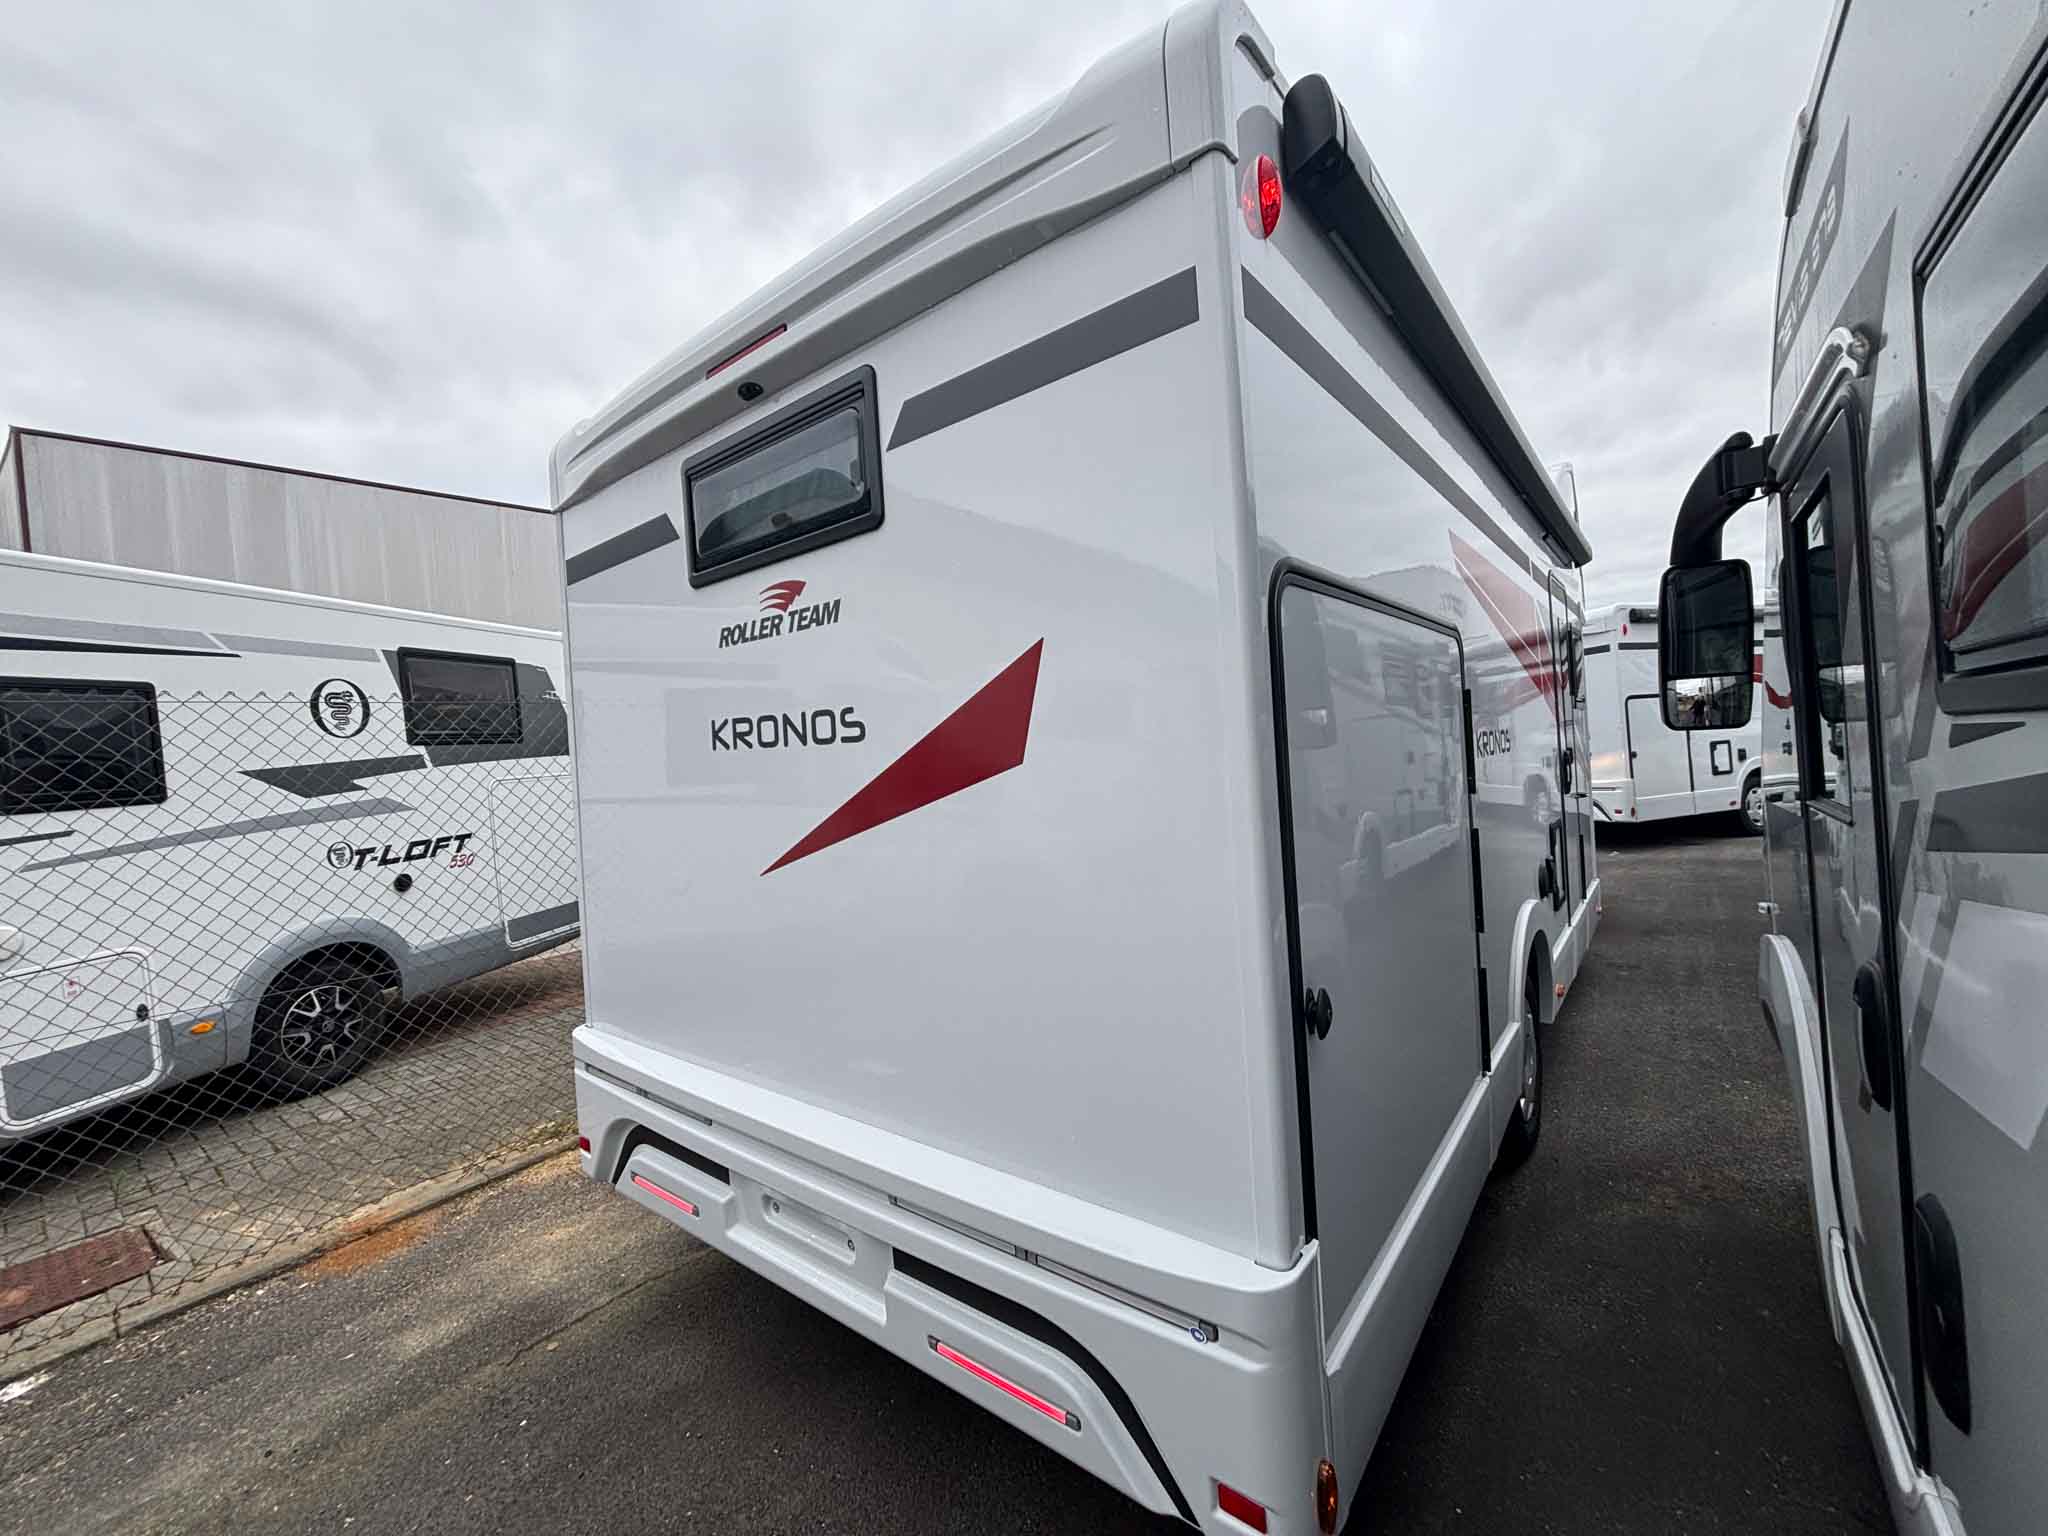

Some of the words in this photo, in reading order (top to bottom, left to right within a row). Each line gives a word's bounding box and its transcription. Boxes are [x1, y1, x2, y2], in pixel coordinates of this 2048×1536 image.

[719, 613, 784, 649] ROLLER
[788, 598, 841, 633] TEAM
[711, 706, 866, 751] KRONOS
[1476, 729, 1511, 759] KRONOS
[353, 832, 473, 871] T-LOFT
[448, 852, 475, 869] 530
